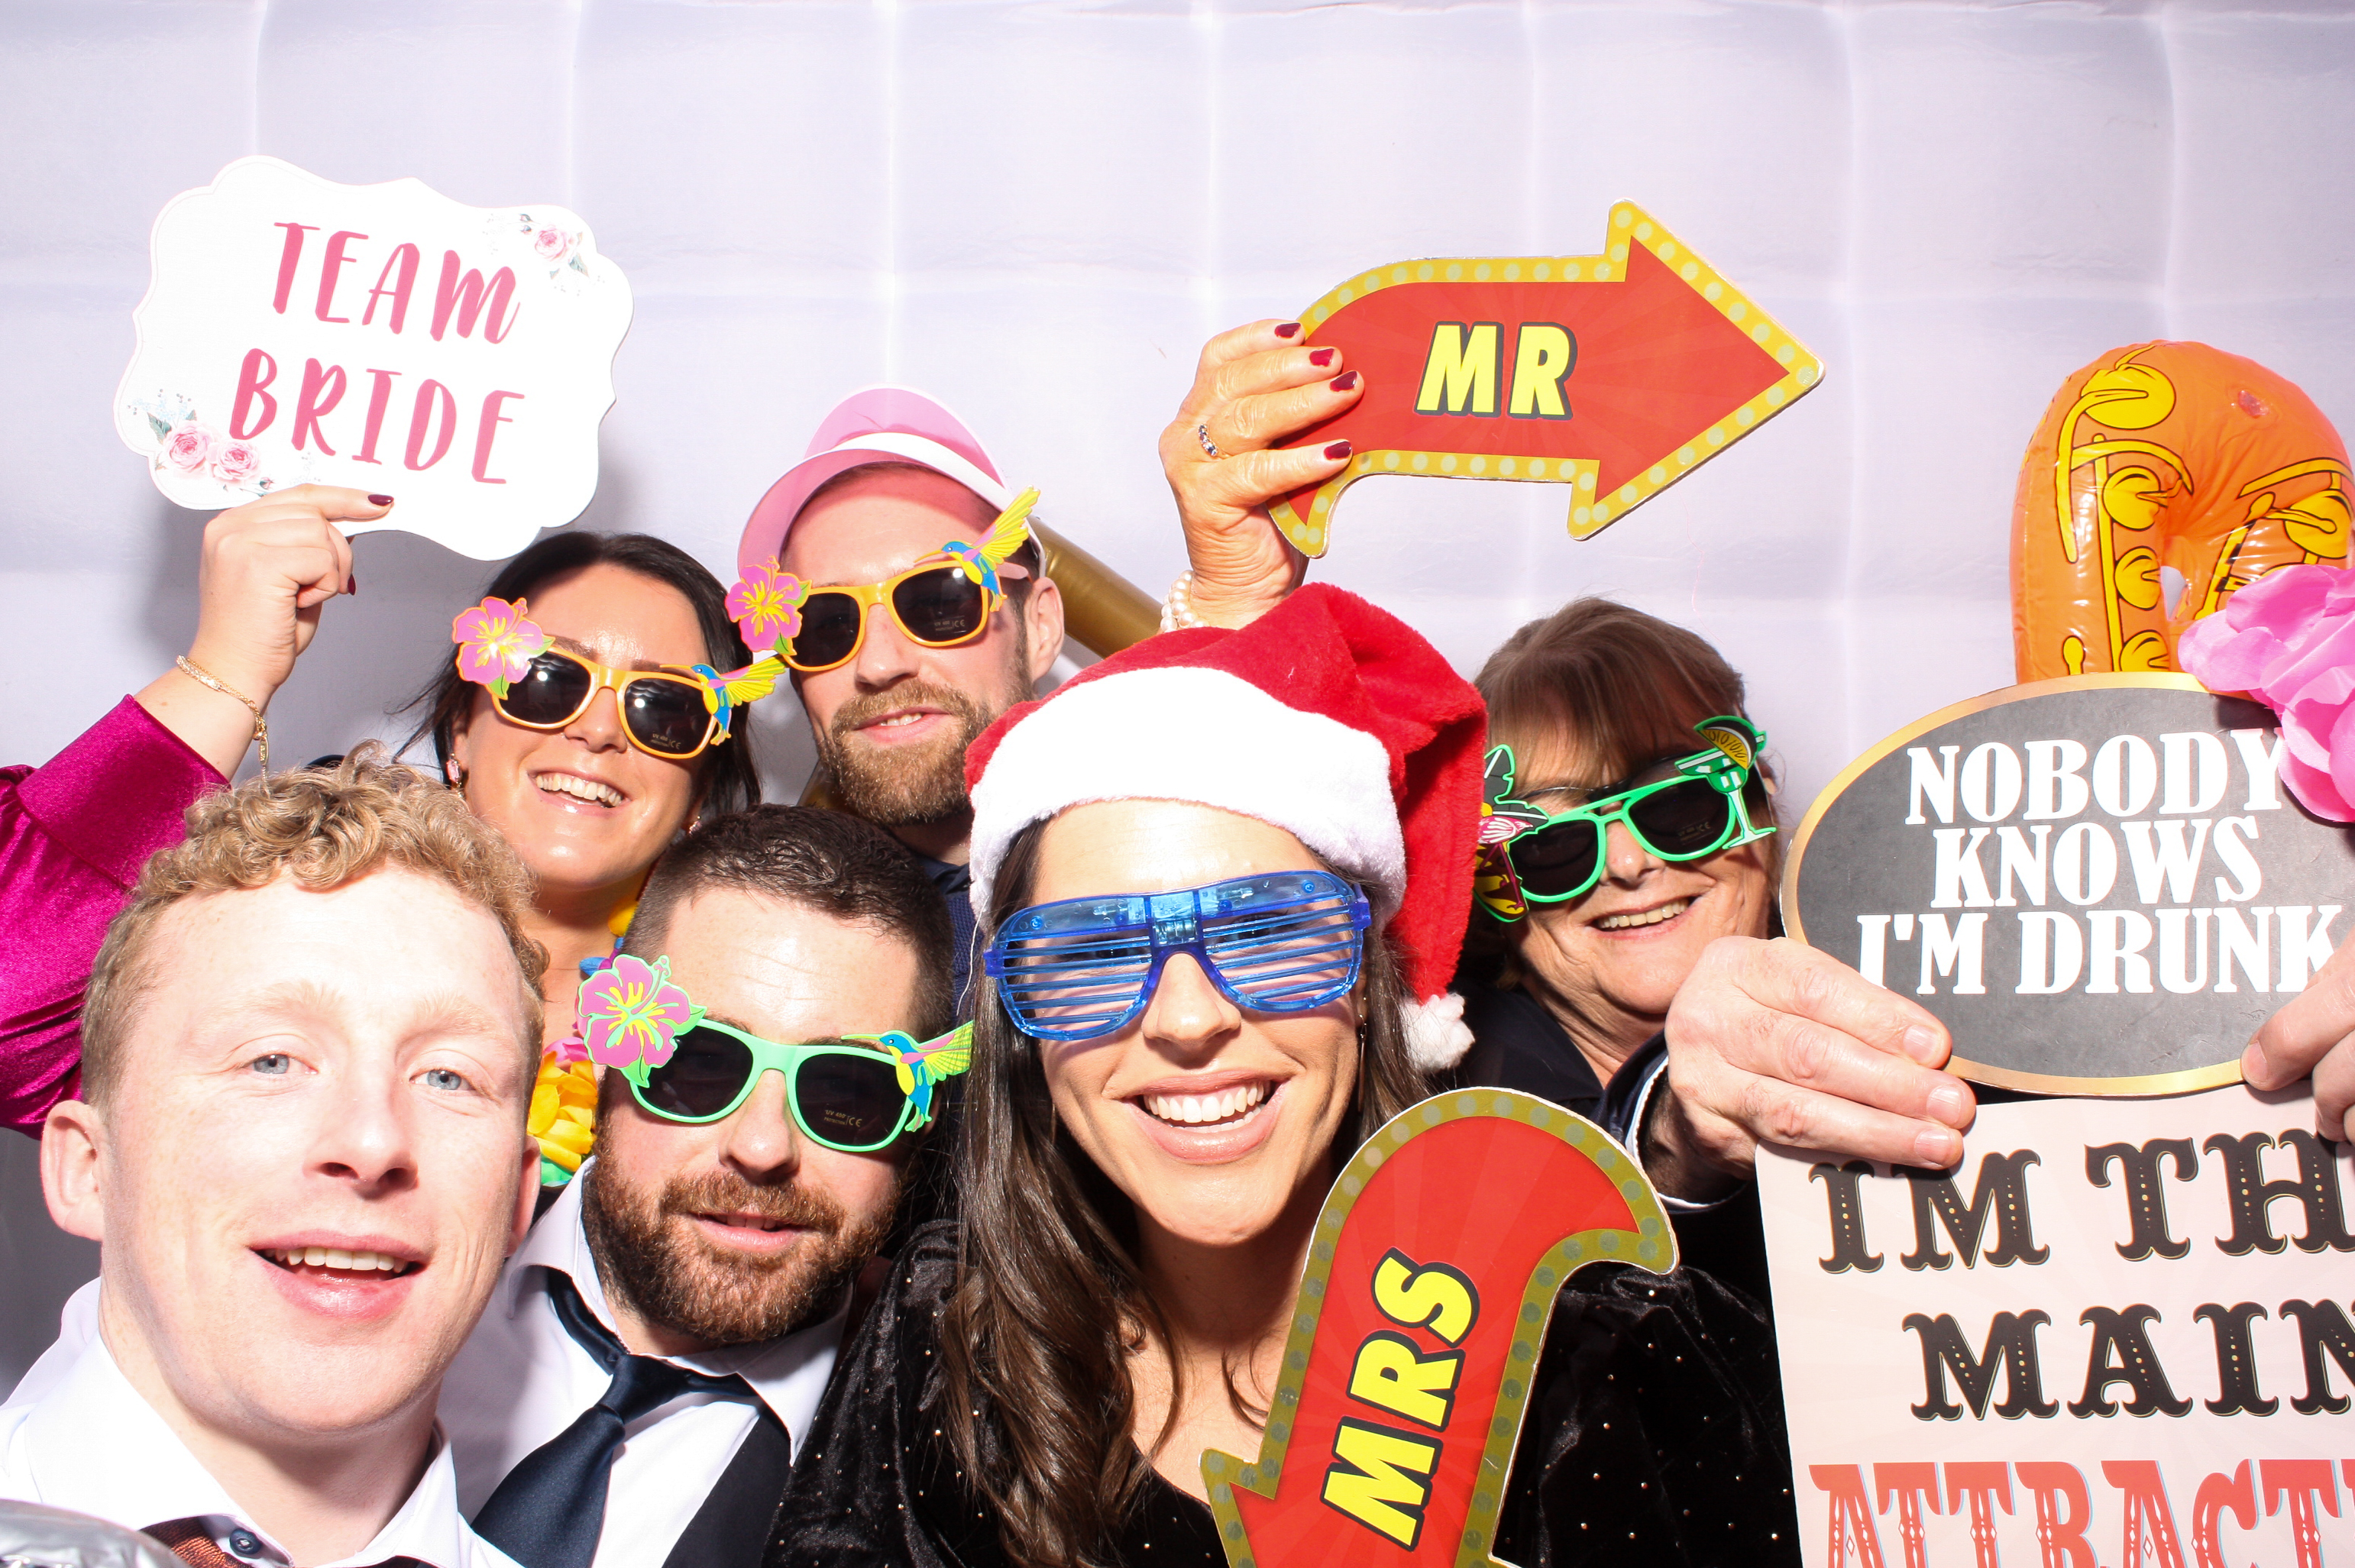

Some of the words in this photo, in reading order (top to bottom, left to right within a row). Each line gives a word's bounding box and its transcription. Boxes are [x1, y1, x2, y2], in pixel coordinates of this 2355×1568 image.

[273, 222, 521, 344] TEAM
[228, 348, 526, 484] BRIDE
[1414, 321, 1578, 421] MR
[1905, 728, 2286, 825] NOBODY
[1930, 815, 2263, 908] KNOWS
[1857, 912, 1988, 994] I'M
[2015, 905, 2343, 994] DRUNK
[1808, 1148, 2050, 1274] IM
[1320, 1246, 1480, 1552] MRS
